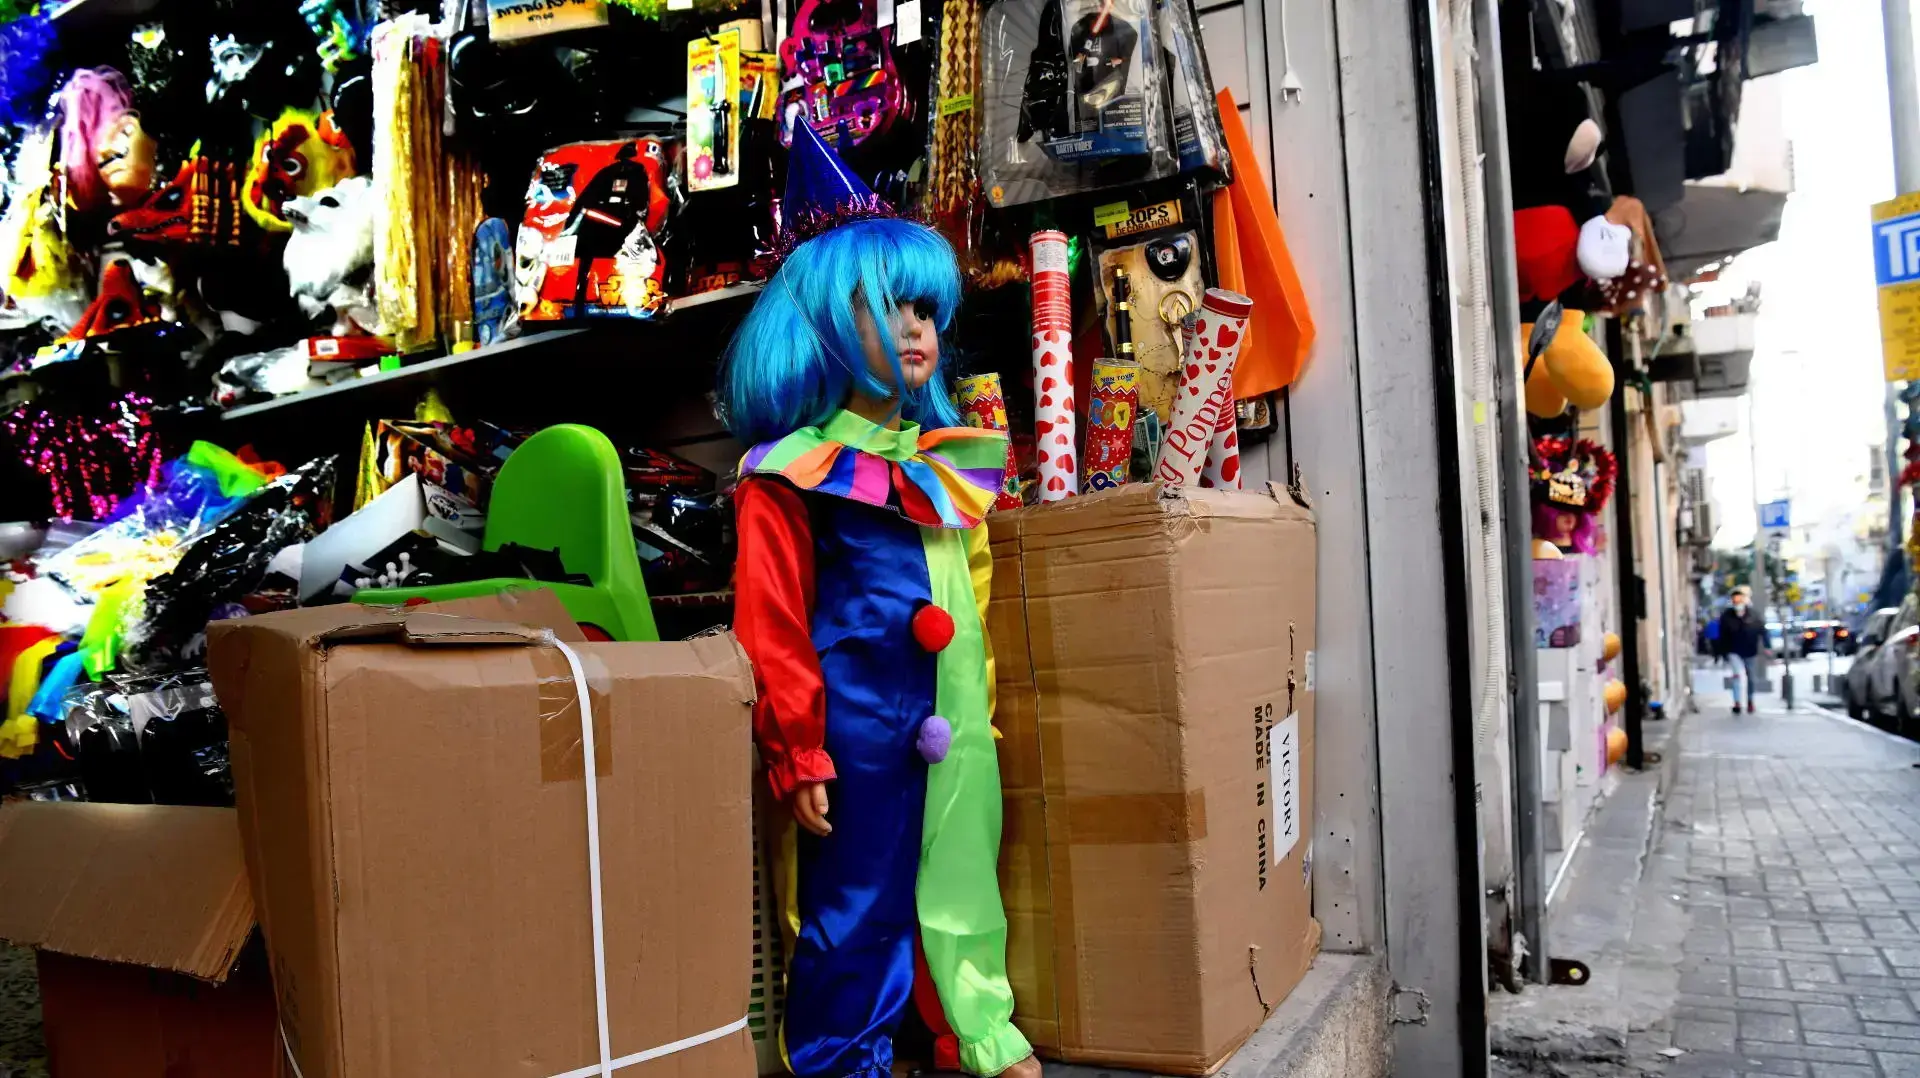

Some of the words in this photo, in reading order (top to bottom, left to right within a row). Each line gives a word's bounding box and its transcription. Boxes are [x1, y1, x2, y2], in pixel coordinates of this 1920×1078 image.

[1055, 142, 1073, 155] DARTH
[1115, 204, 1169, 229] ROPS
[1116, 217, 1171, 237] DECORATION
[1117, 373, 1135, 381] TOXIC
[1254, 705, 1264, 771] MADE
[1257, 782, 1265, 807] IN
[1282, 731, 1292, 837] VICTORY
[1258, 818, 1266, 892] CHINA
